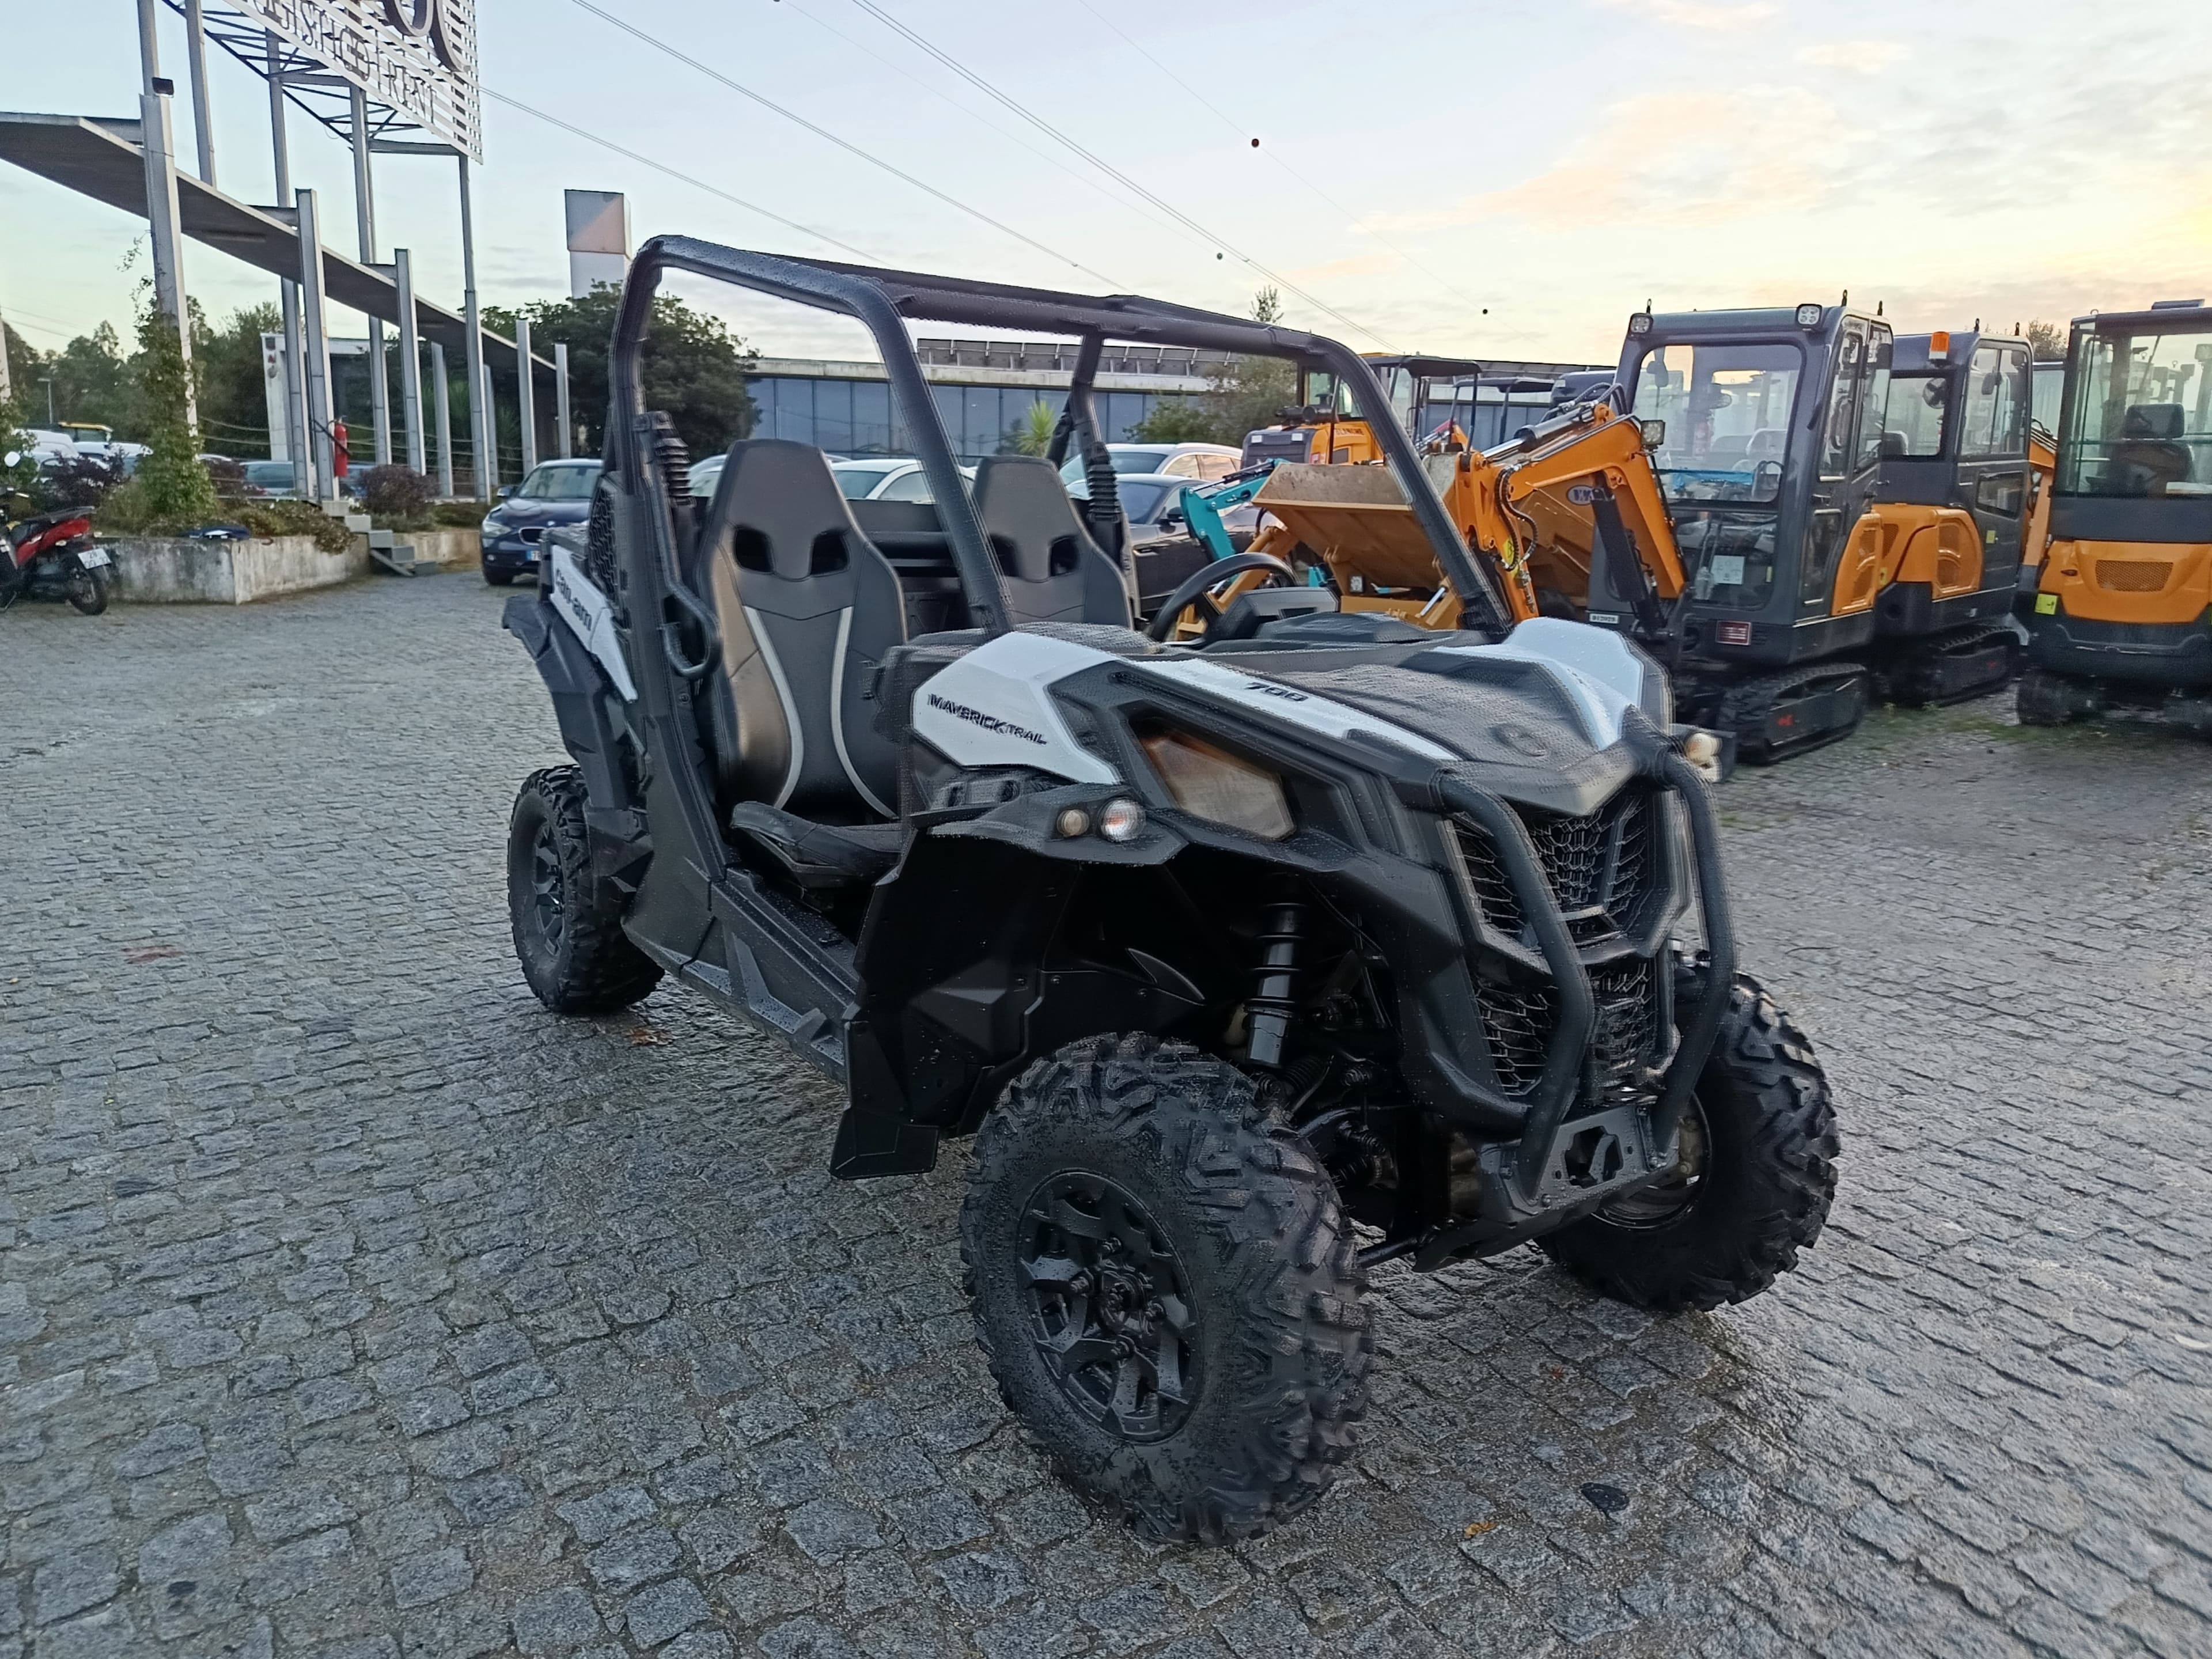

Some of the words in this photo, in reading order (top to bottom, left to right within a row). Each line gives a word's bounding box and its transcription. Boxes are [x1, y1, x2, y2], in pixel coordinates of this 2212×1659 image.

[1244, 682, 1309, 702] 700
[928, 694, 1006, 734] MAVERICK
[1007, 724, 1048, 745] TRAIL
